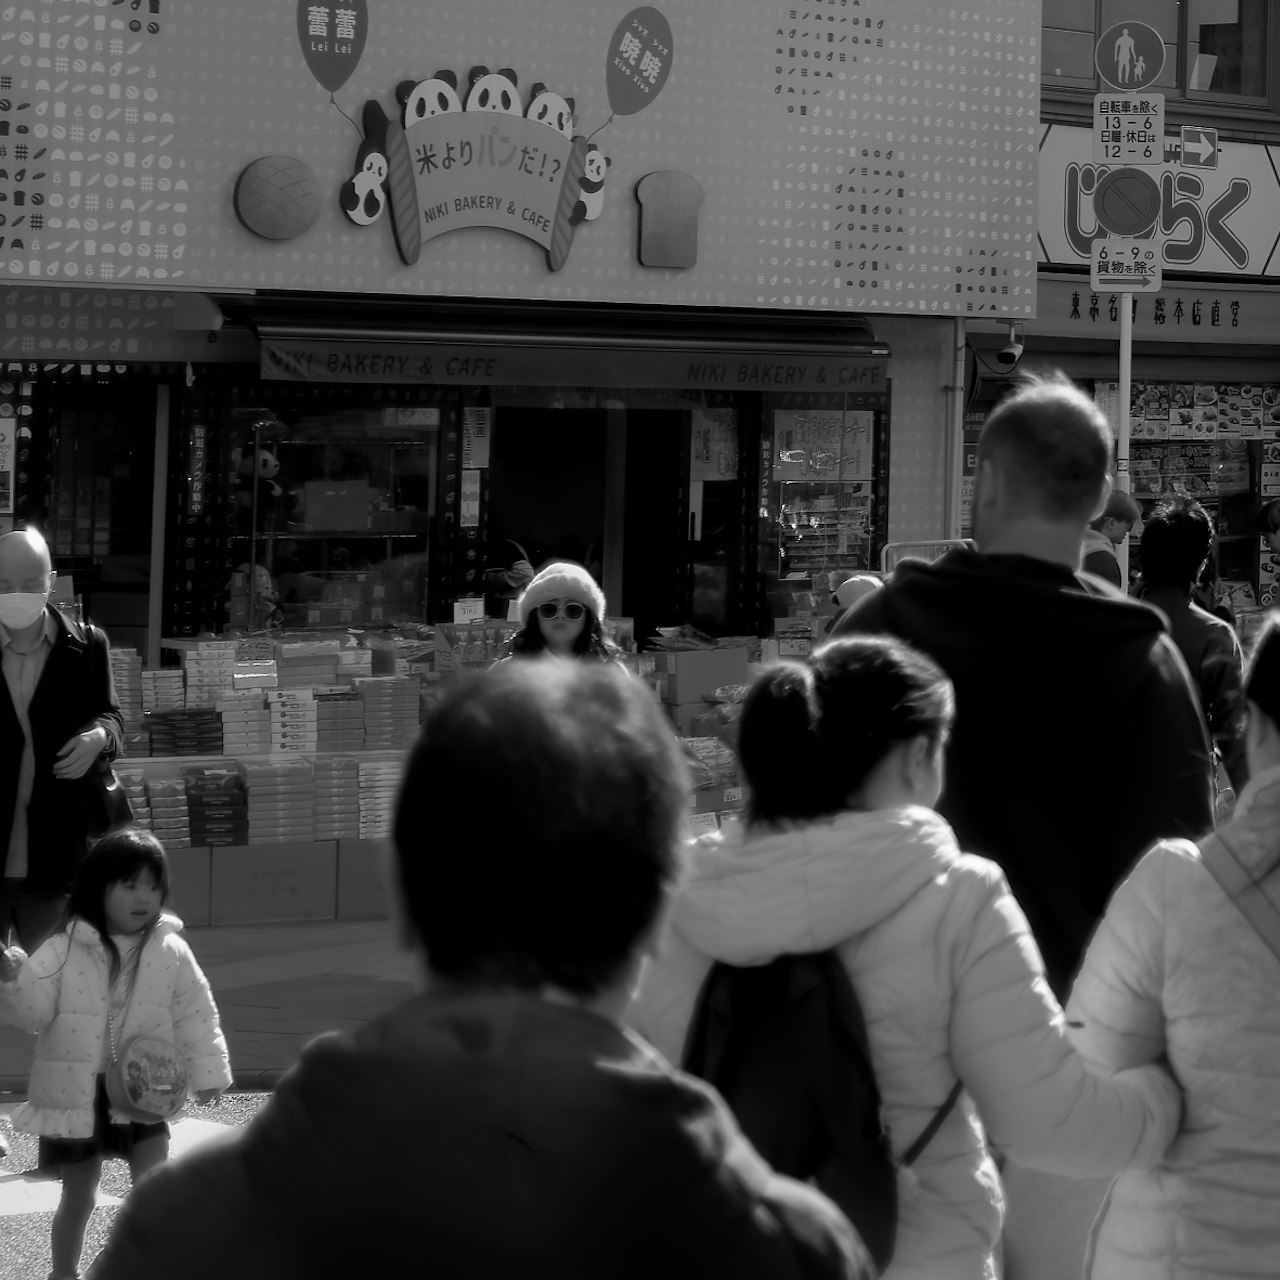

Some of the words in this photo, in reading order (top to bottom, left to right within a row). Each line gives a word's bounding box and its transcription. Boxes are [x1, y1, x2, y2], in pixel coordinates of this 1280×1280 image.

[1099, 100, 1158, 114] 自転車を除く
[424, 201, 449, 223] NIKI
[454, 195, 502, 212] BAKERY
[506, 201, 516, 216] &
[521, 207, 551, 233] CAFE
[1064, 162, 1251, 270] じらく
[1096, 260, 1156, 275] 貨物を除く
[1069, 291, 1138, 324] 東京名
[326, 353, 408, 376] BAKERY
[418, 360, 433, 375] &
[445, 357, 497, 377] CAFE
[686, 363, 729, 383] NIKI
[736, 364, 809, 385] BAKERY
[815, 367, 829, 384] &
[837, 365, 881, 385] CAFE
